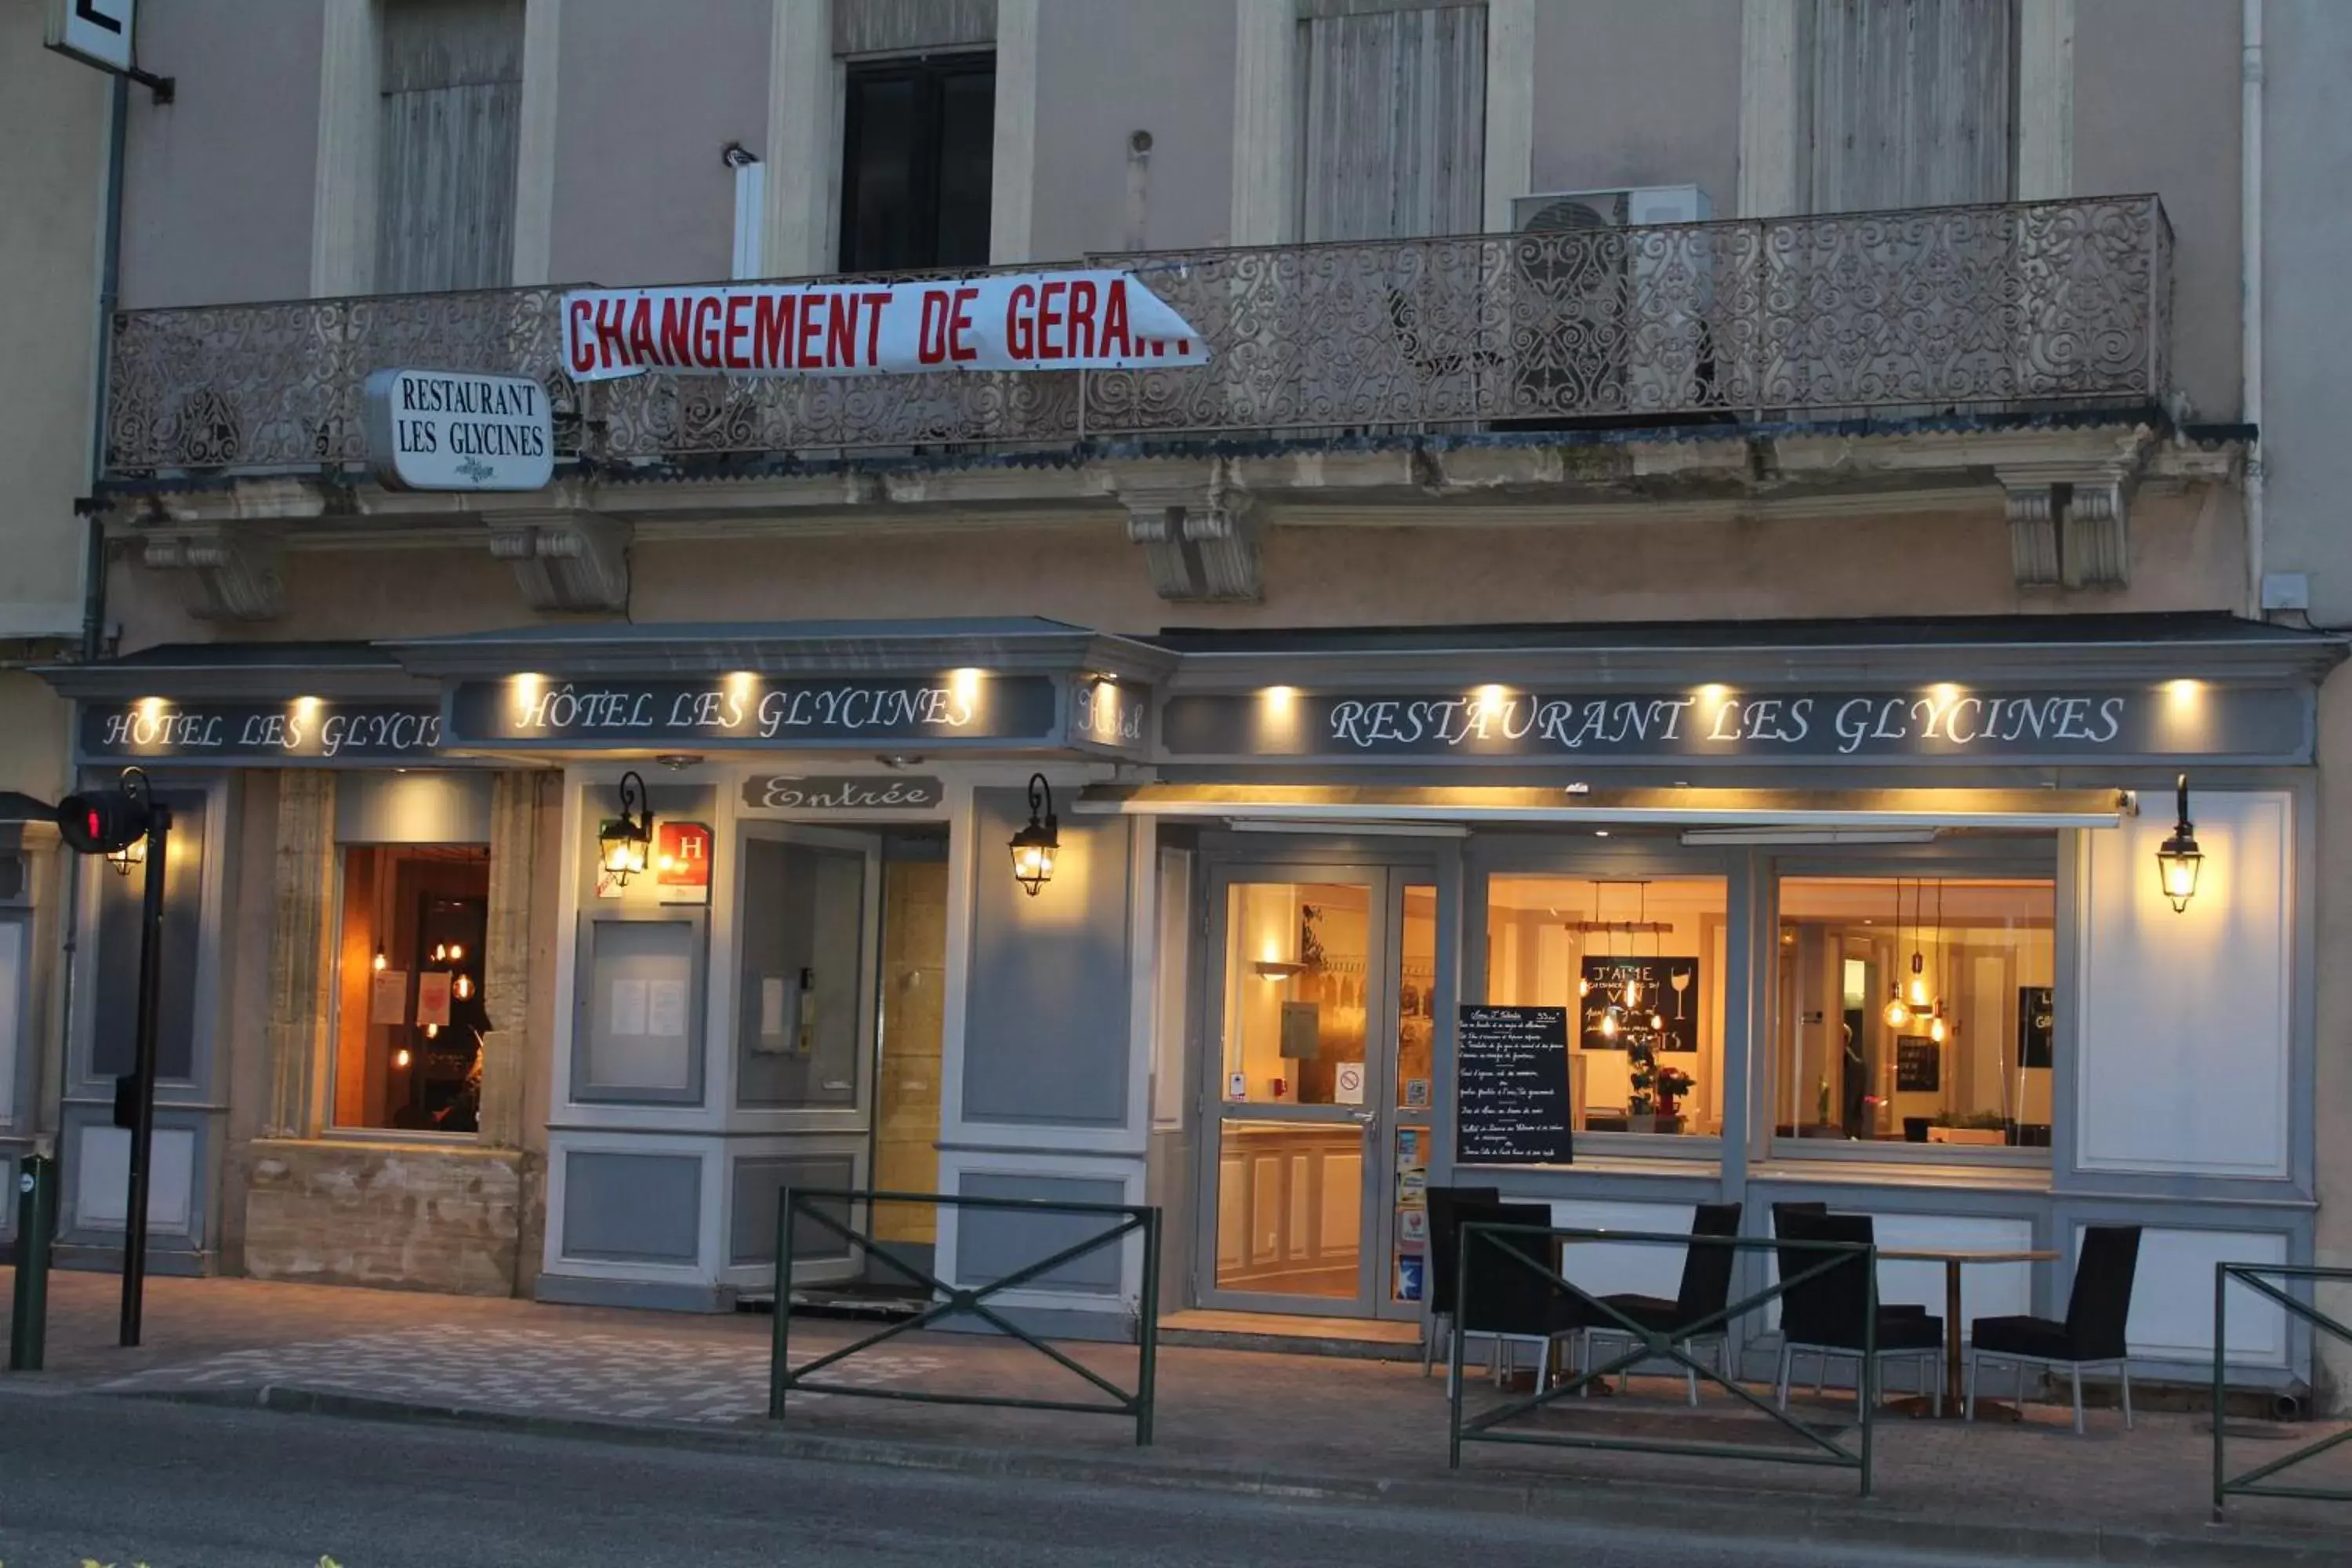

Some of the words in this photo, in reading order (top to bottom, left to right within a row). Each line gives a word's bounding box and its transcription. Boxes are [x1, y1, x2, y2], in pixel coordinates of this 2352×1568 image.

[570, 292, 892, 372] CHANGEMENT
[919, 289, 978, 364] DE
[1007, 279, 1189, 361] GERA
[402, 378, 535, 417] RESTAURANT
[399, 421, 436, 453] LES
[450, 422, 544, 457] GLYCINES
[516, 684, 652, 728] HÔTEL
[666, 692, 744, 727] LES
[758, 687, 971, 737] GLYCINES
[1330, 695, 1696, 747] RESTAURANT
[1708, 698, 1813, 742] LES
[1835, 697, 2125, 753] GLYCINES
[238, 713, 301, 748] LES
[760, 776, 930, 808] Entrée
[681, 837, 702, 858] H
